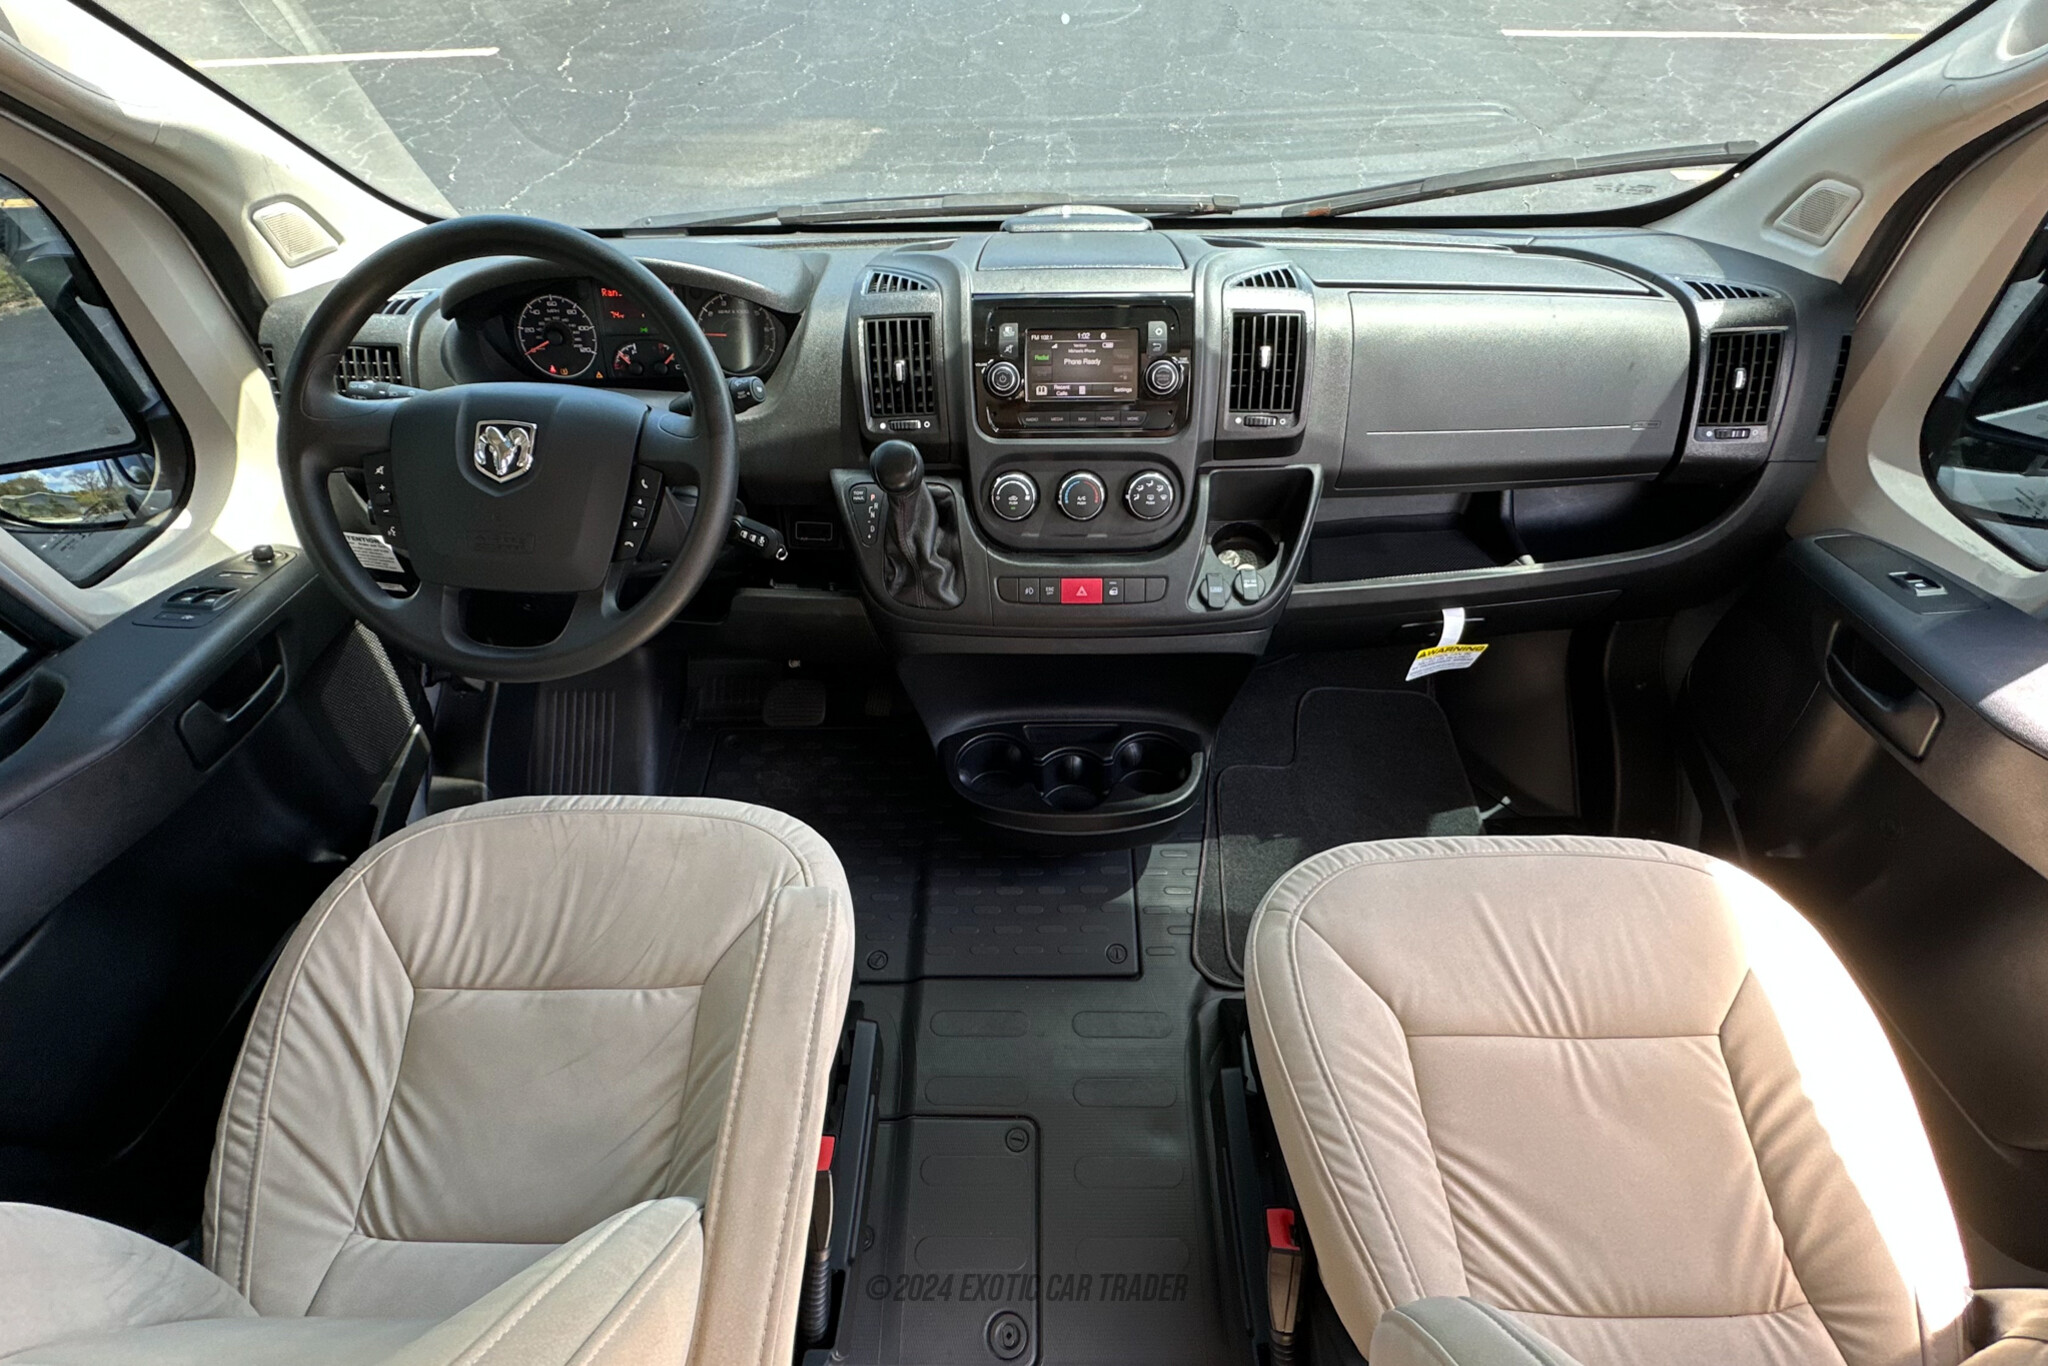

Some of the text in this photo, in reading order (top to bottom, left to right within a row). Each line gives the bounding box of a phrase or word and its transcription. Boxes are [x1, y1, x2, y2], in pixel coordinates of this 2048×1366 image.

[1077, 332, 1091, 340] 1:02
[1082, 358, 1101, 366] Ready
[870, 493, 876, 501] P
[1427, 645, 1486, 656] WARNING
